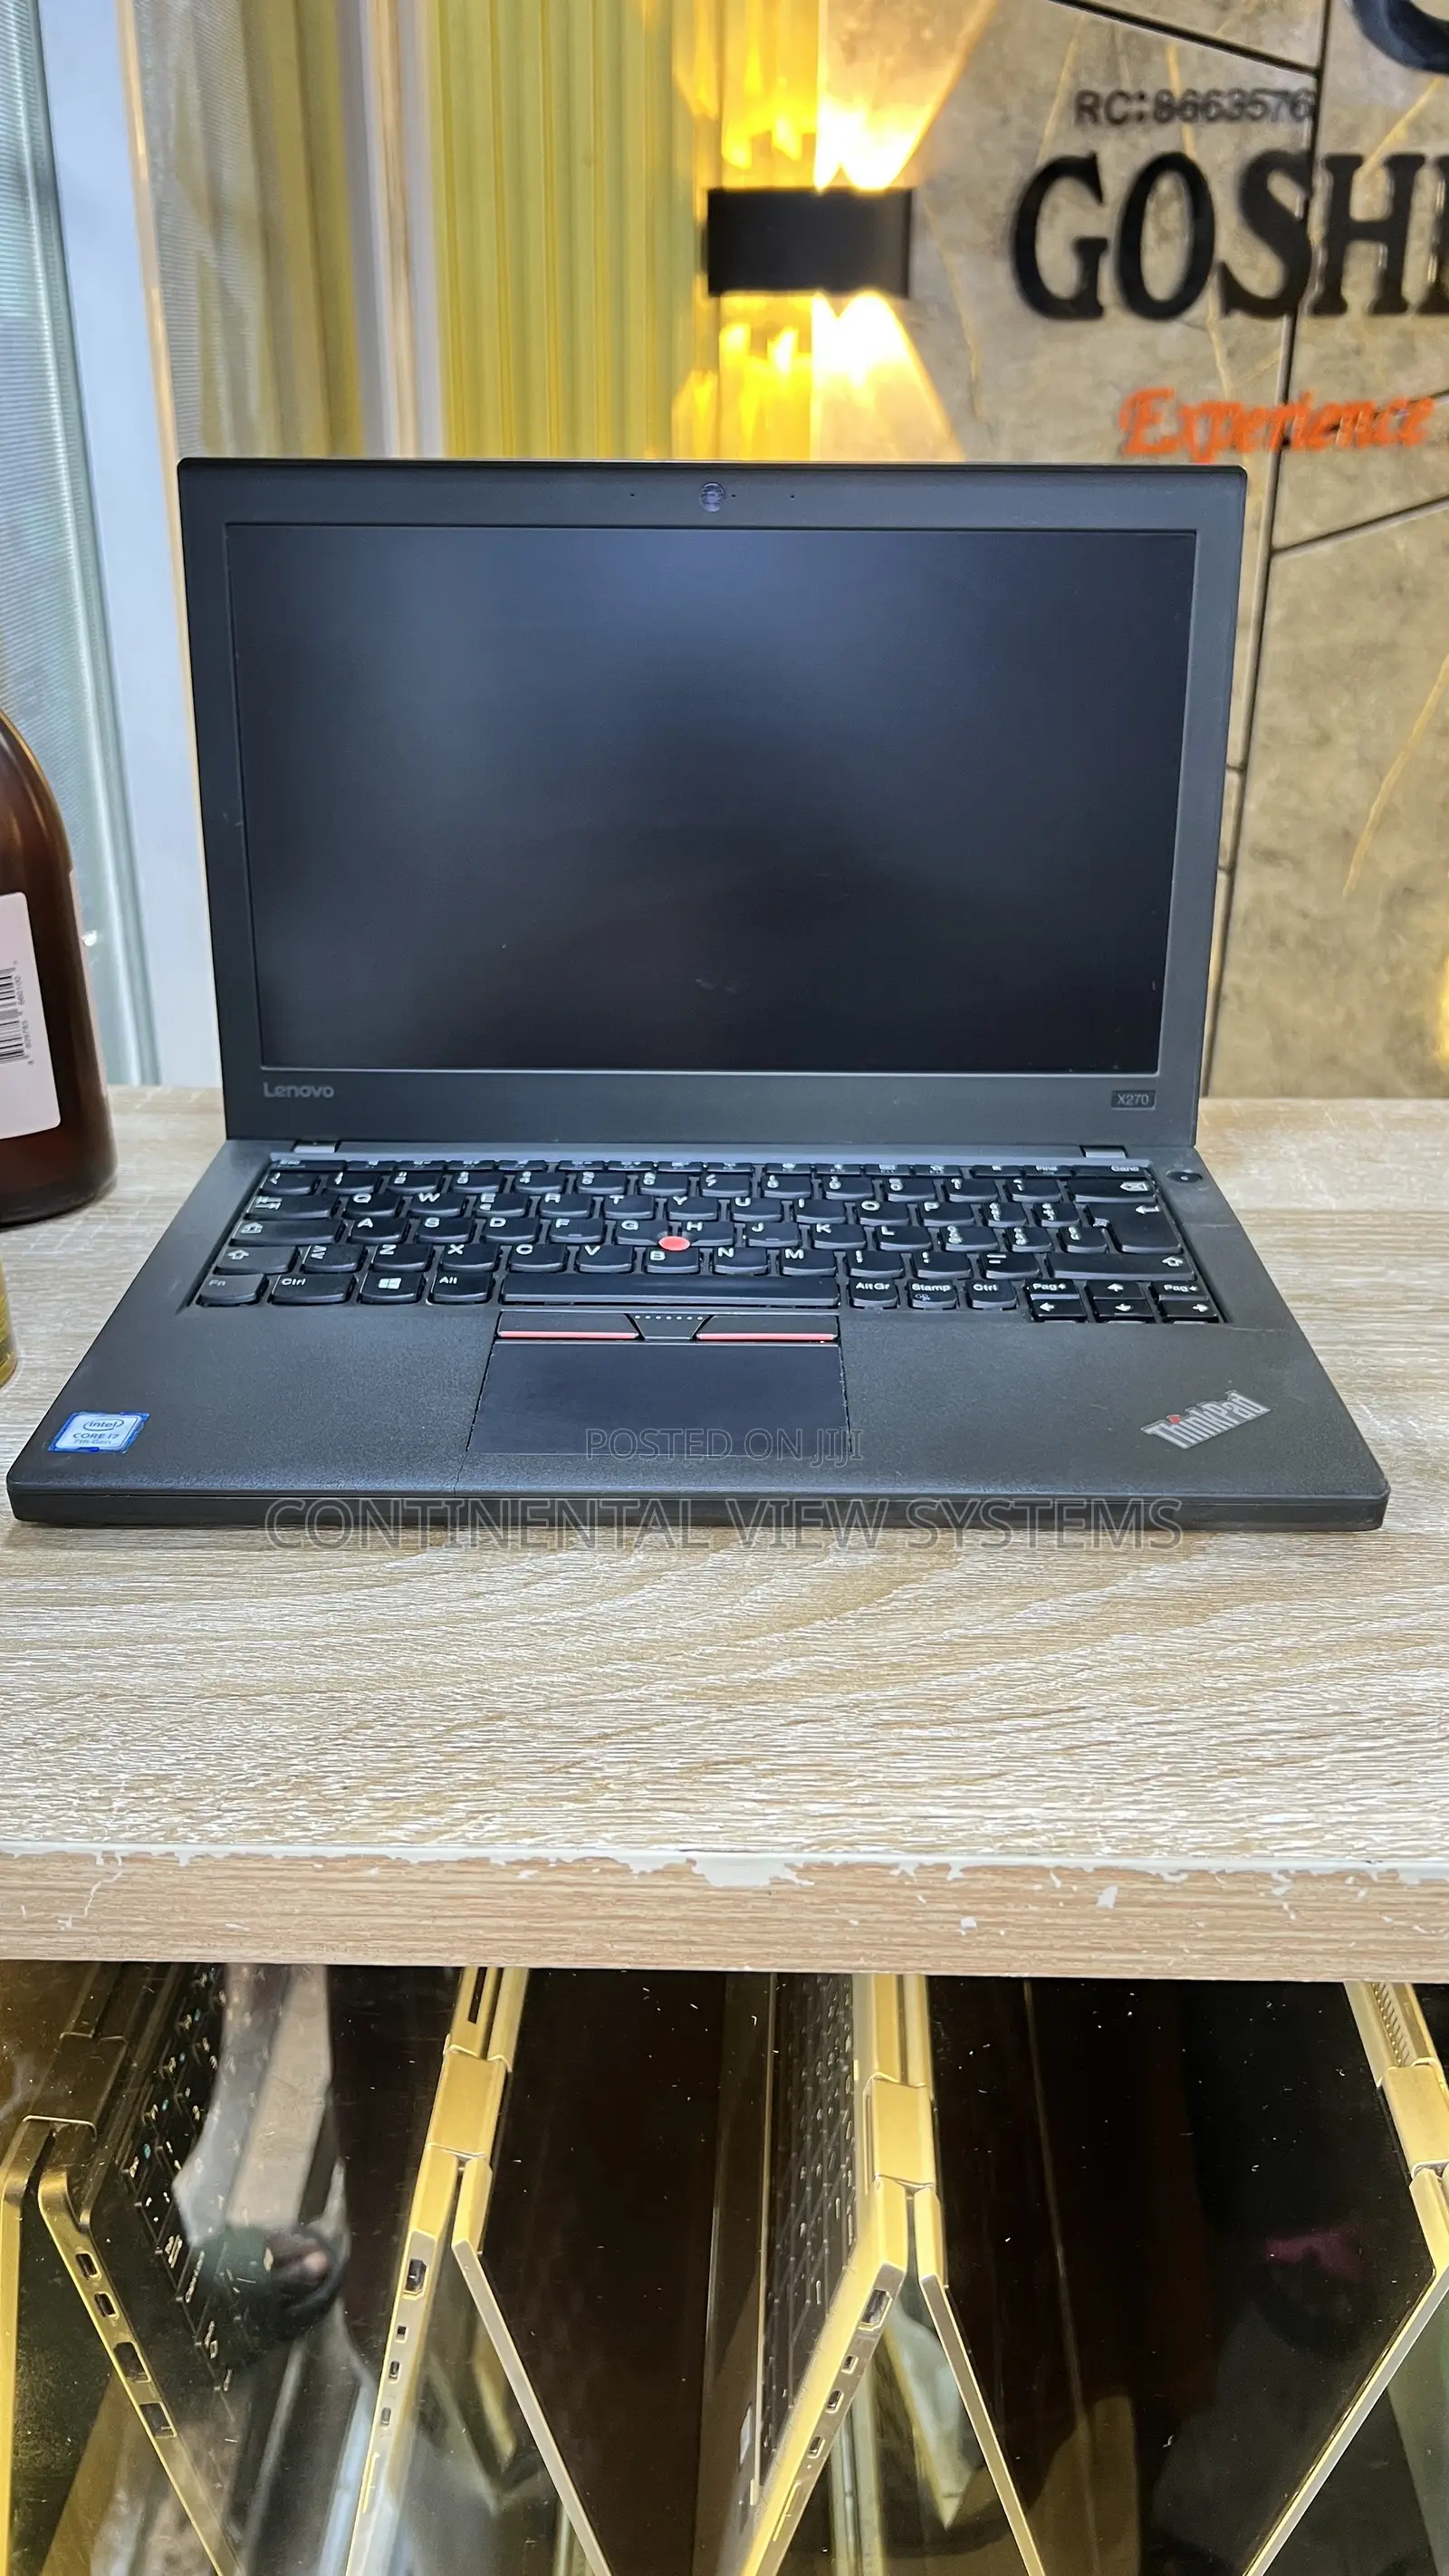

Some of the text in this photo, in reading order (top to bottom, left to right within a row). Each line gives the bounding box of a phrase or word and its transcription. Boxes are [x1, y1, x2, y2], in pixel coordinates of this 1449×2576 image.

[1118, 387, 1435, 464] Experience
[263, 1082, 335, 1099] Lenovo
[1117, 1093, 1149, 1106] X270
[352, 1192, 372, 1203] Q
[417, 1192, 441, 1202] W
[609, 1194, 625, 1204] T
[672, 1195, 688, 1206] Y
[734, 1195, 752, 1207] U
[860, 1200, 880, 1211] O
[357, 1217, 374, 1228] A
[489, 1217, 507, 1228] D
[555, 1218, 571, 1229] F
[620, 1220, 639, 1231] G
[686, 1220, 703, 1231] H
[750, 1221, 764, 1232] J
[816, 1222, 831, 1234] K
[880, 1224, 895, 1236] L
[379, 1244, 397, 1255] Z
[447, 1243, 465, 1255] X
[515, 1243, 533, 1255] C
[584, 1244, 601, 1256] V
[717, 1247, 734, 1258] N
[784, 1247, 805, 1259] M
[649, 1250, 667, 1261] B
[207, 1278, 226, 1288] Fn
[281, 1277, 307, 1287] Ctrl
[438, 1276, 457, 1285] Alt
[911, 1282, 951, 1294] Stamp
[973, 1283, 998, 1292] Ctrl
[87, 1420, 119, 1429] intel
[1140, 1390, 1271, 1449] ThinkPad
